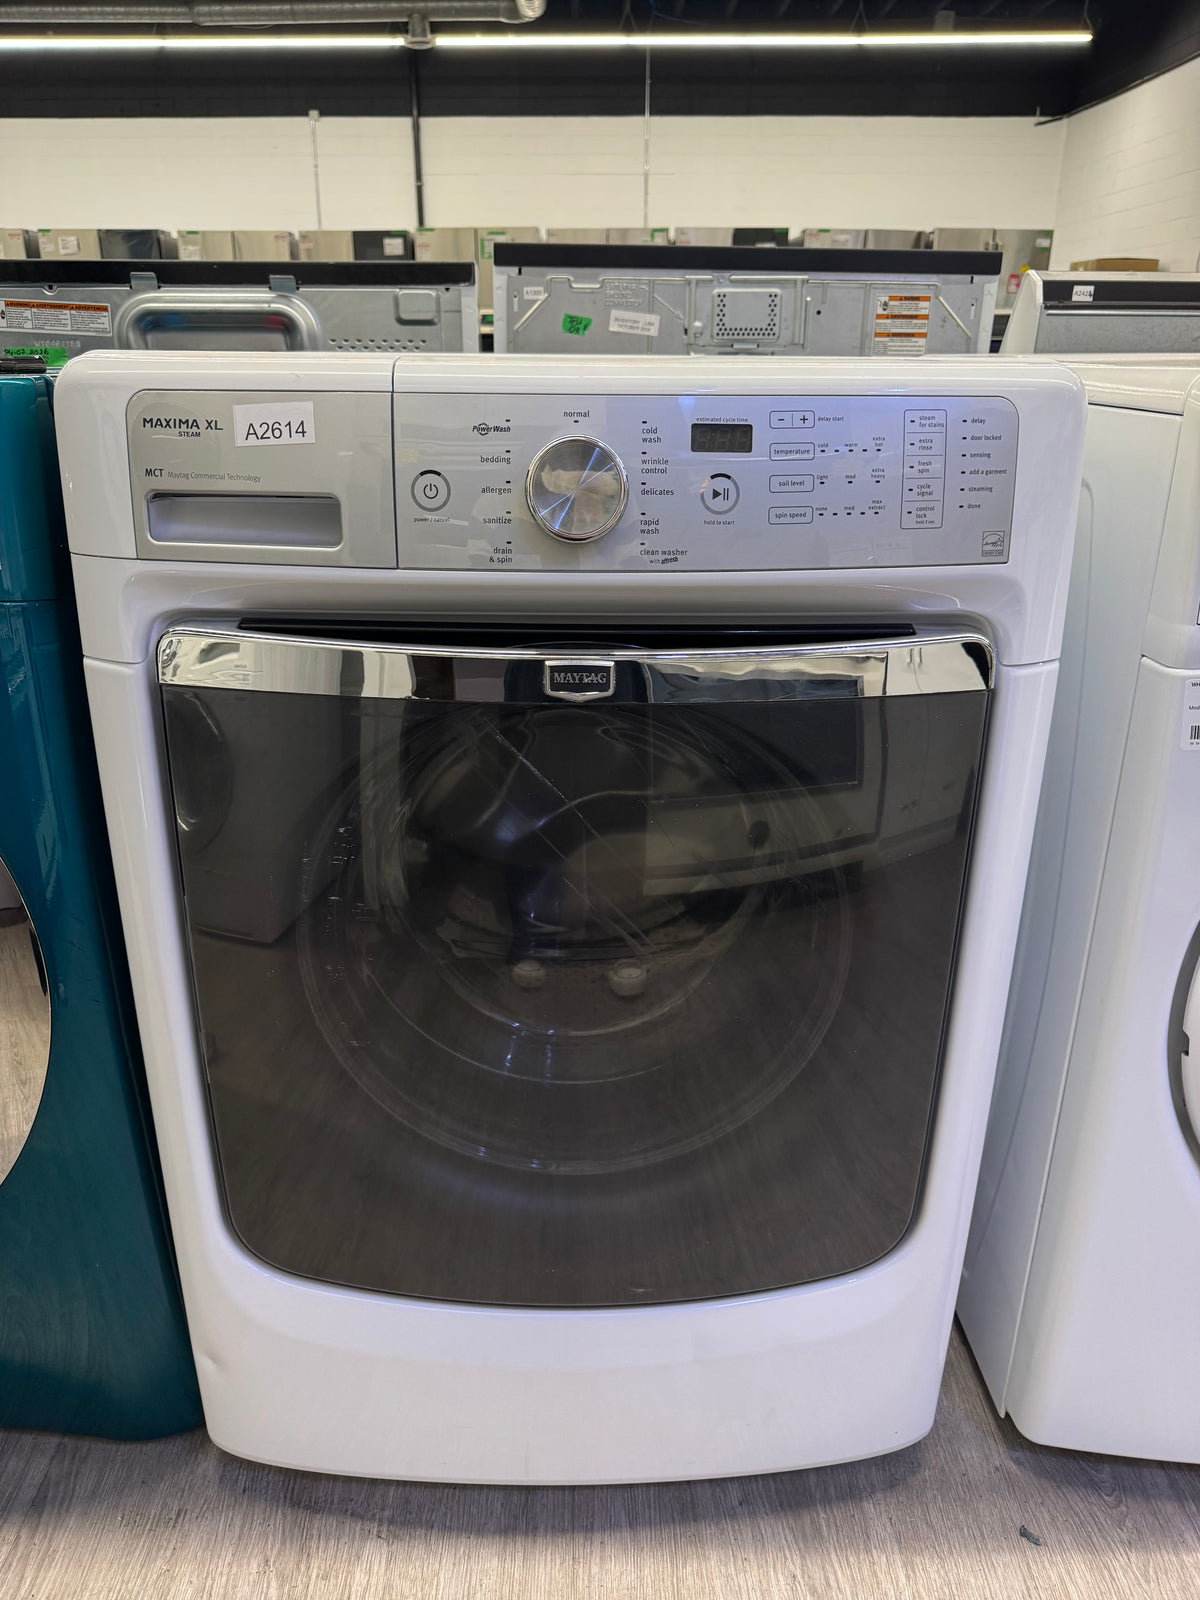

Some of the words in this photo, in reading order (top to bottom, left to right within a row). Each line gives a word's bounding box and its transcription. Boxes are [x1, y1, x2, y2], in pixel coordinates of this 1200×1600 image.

[142, 418, 200, 429] MAXIMA
[205, 419, 223, 430] XL
[245, 420, 307, 441] A2614
[480, 456, 511, 464] bedding
[145, 468, 164, 478] MCT
[168, 472, 190, 480] Maytag
[191, 472, 225, 480] Commercial
[226, 474, 261, 482] Technology
[554, 672, 606, 684] MAYTAG
